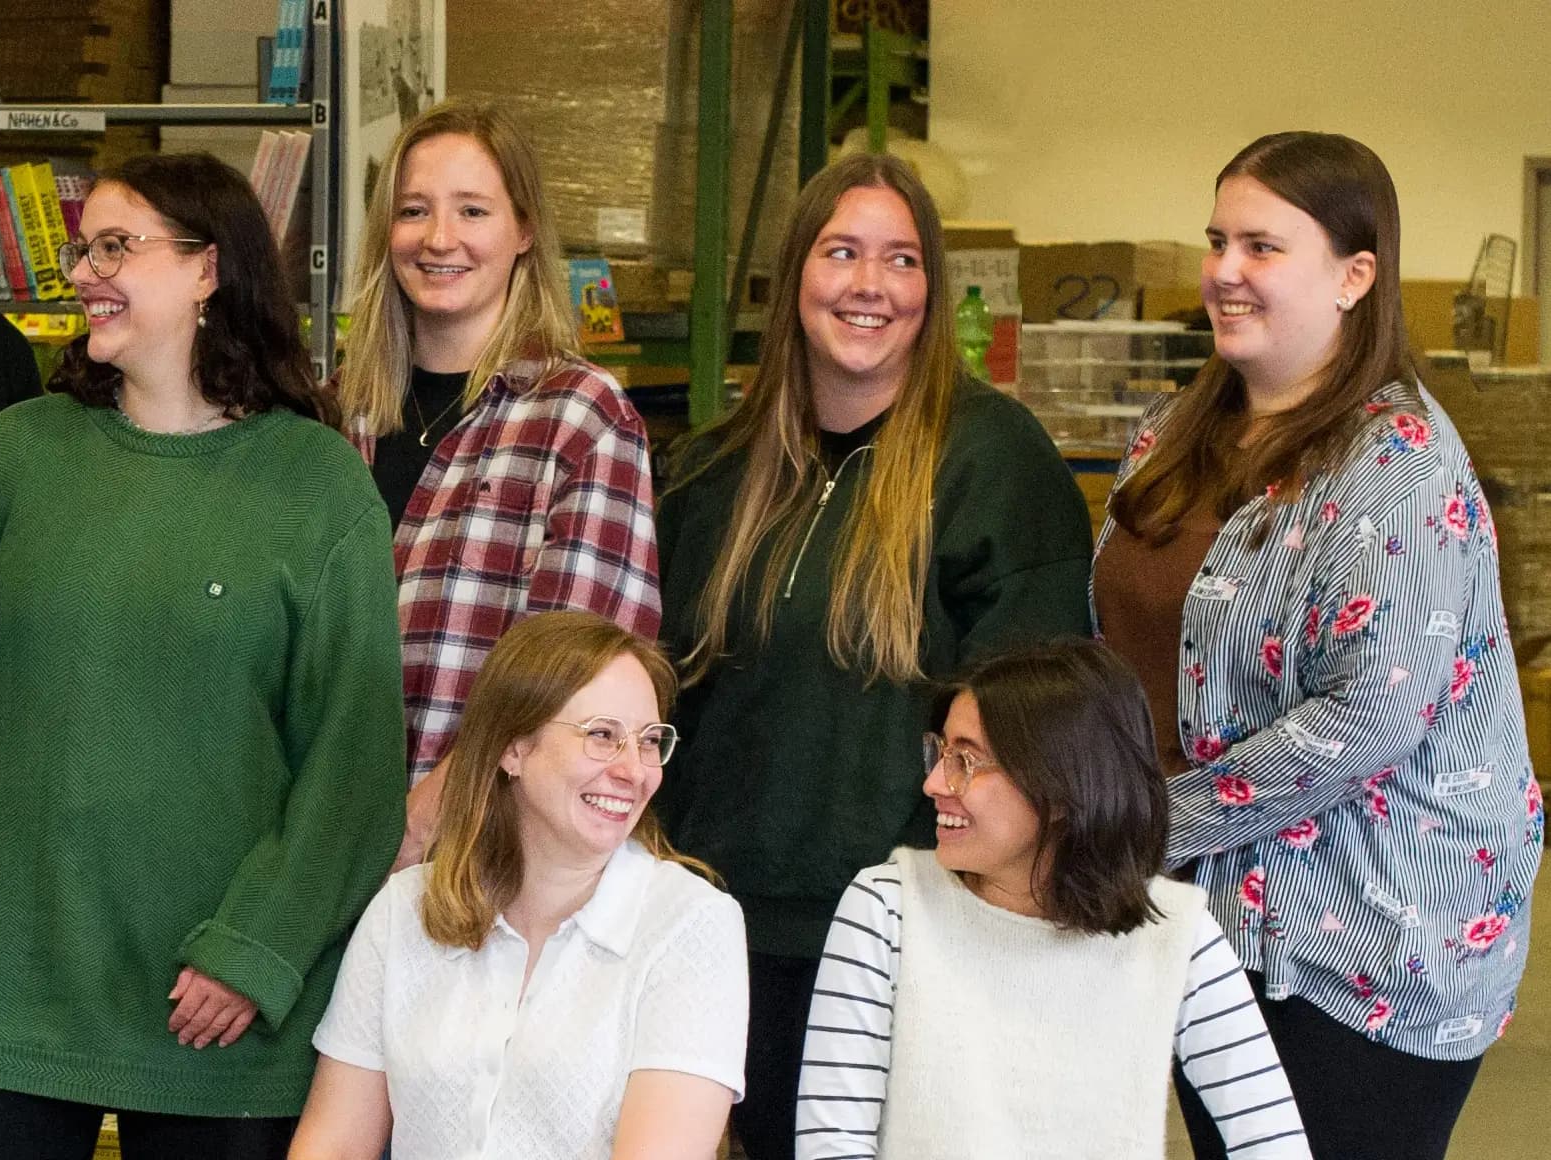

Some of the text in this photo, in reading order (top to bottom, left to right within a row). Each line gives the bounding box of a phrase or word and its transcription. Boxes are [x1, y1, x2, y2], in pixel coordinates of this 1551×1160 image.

[315, 2, 327, 20] A
[315, 104, 327, 123] B
[29, 234, 44, 266] ALLES
[312, 250, 325, 269] C
